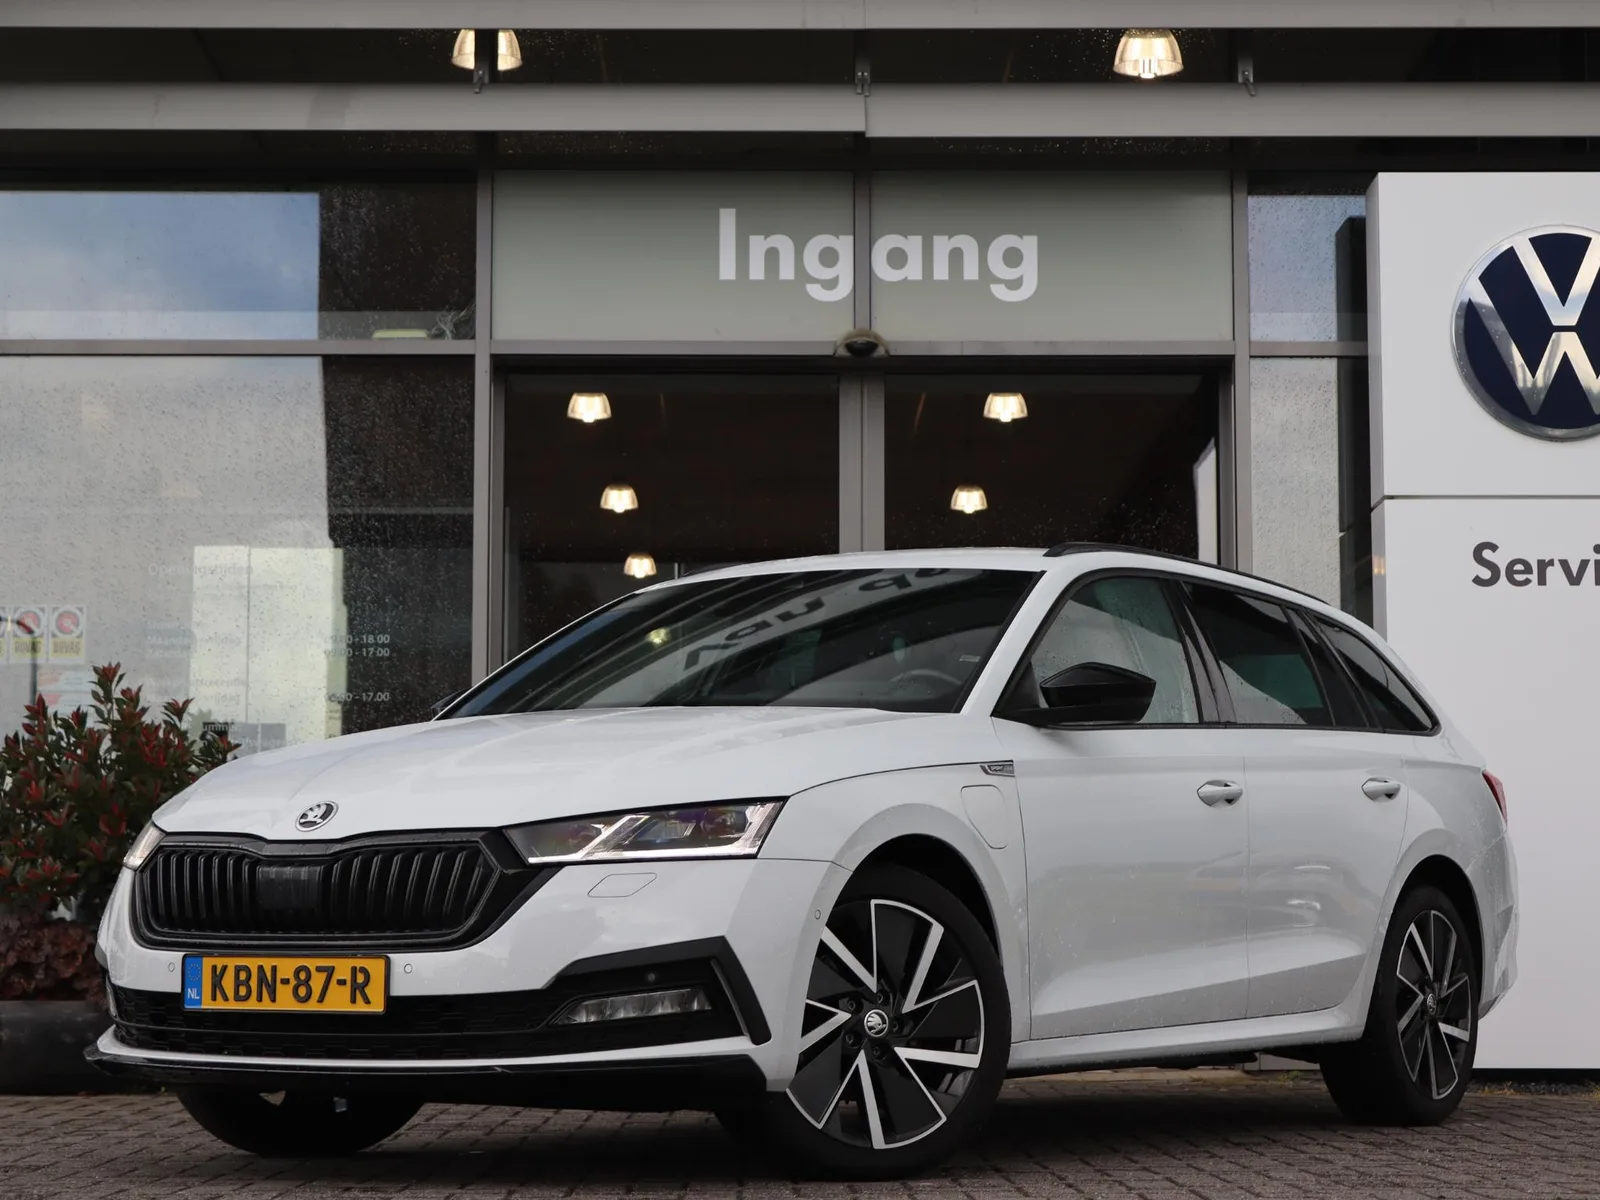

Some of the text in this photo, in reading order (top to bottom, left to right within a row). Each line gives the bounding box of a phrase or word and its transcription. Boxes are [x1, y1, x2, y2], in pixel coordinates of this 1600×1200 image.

[718, 208, 1039, 302] Ingang
[1471, 541, 1600, 588] Servi
[362, 692, 390, 702] 17.00
[187, 988, 200, 1000] NL
[210, 964, 371, 1005] KBN-87-R
